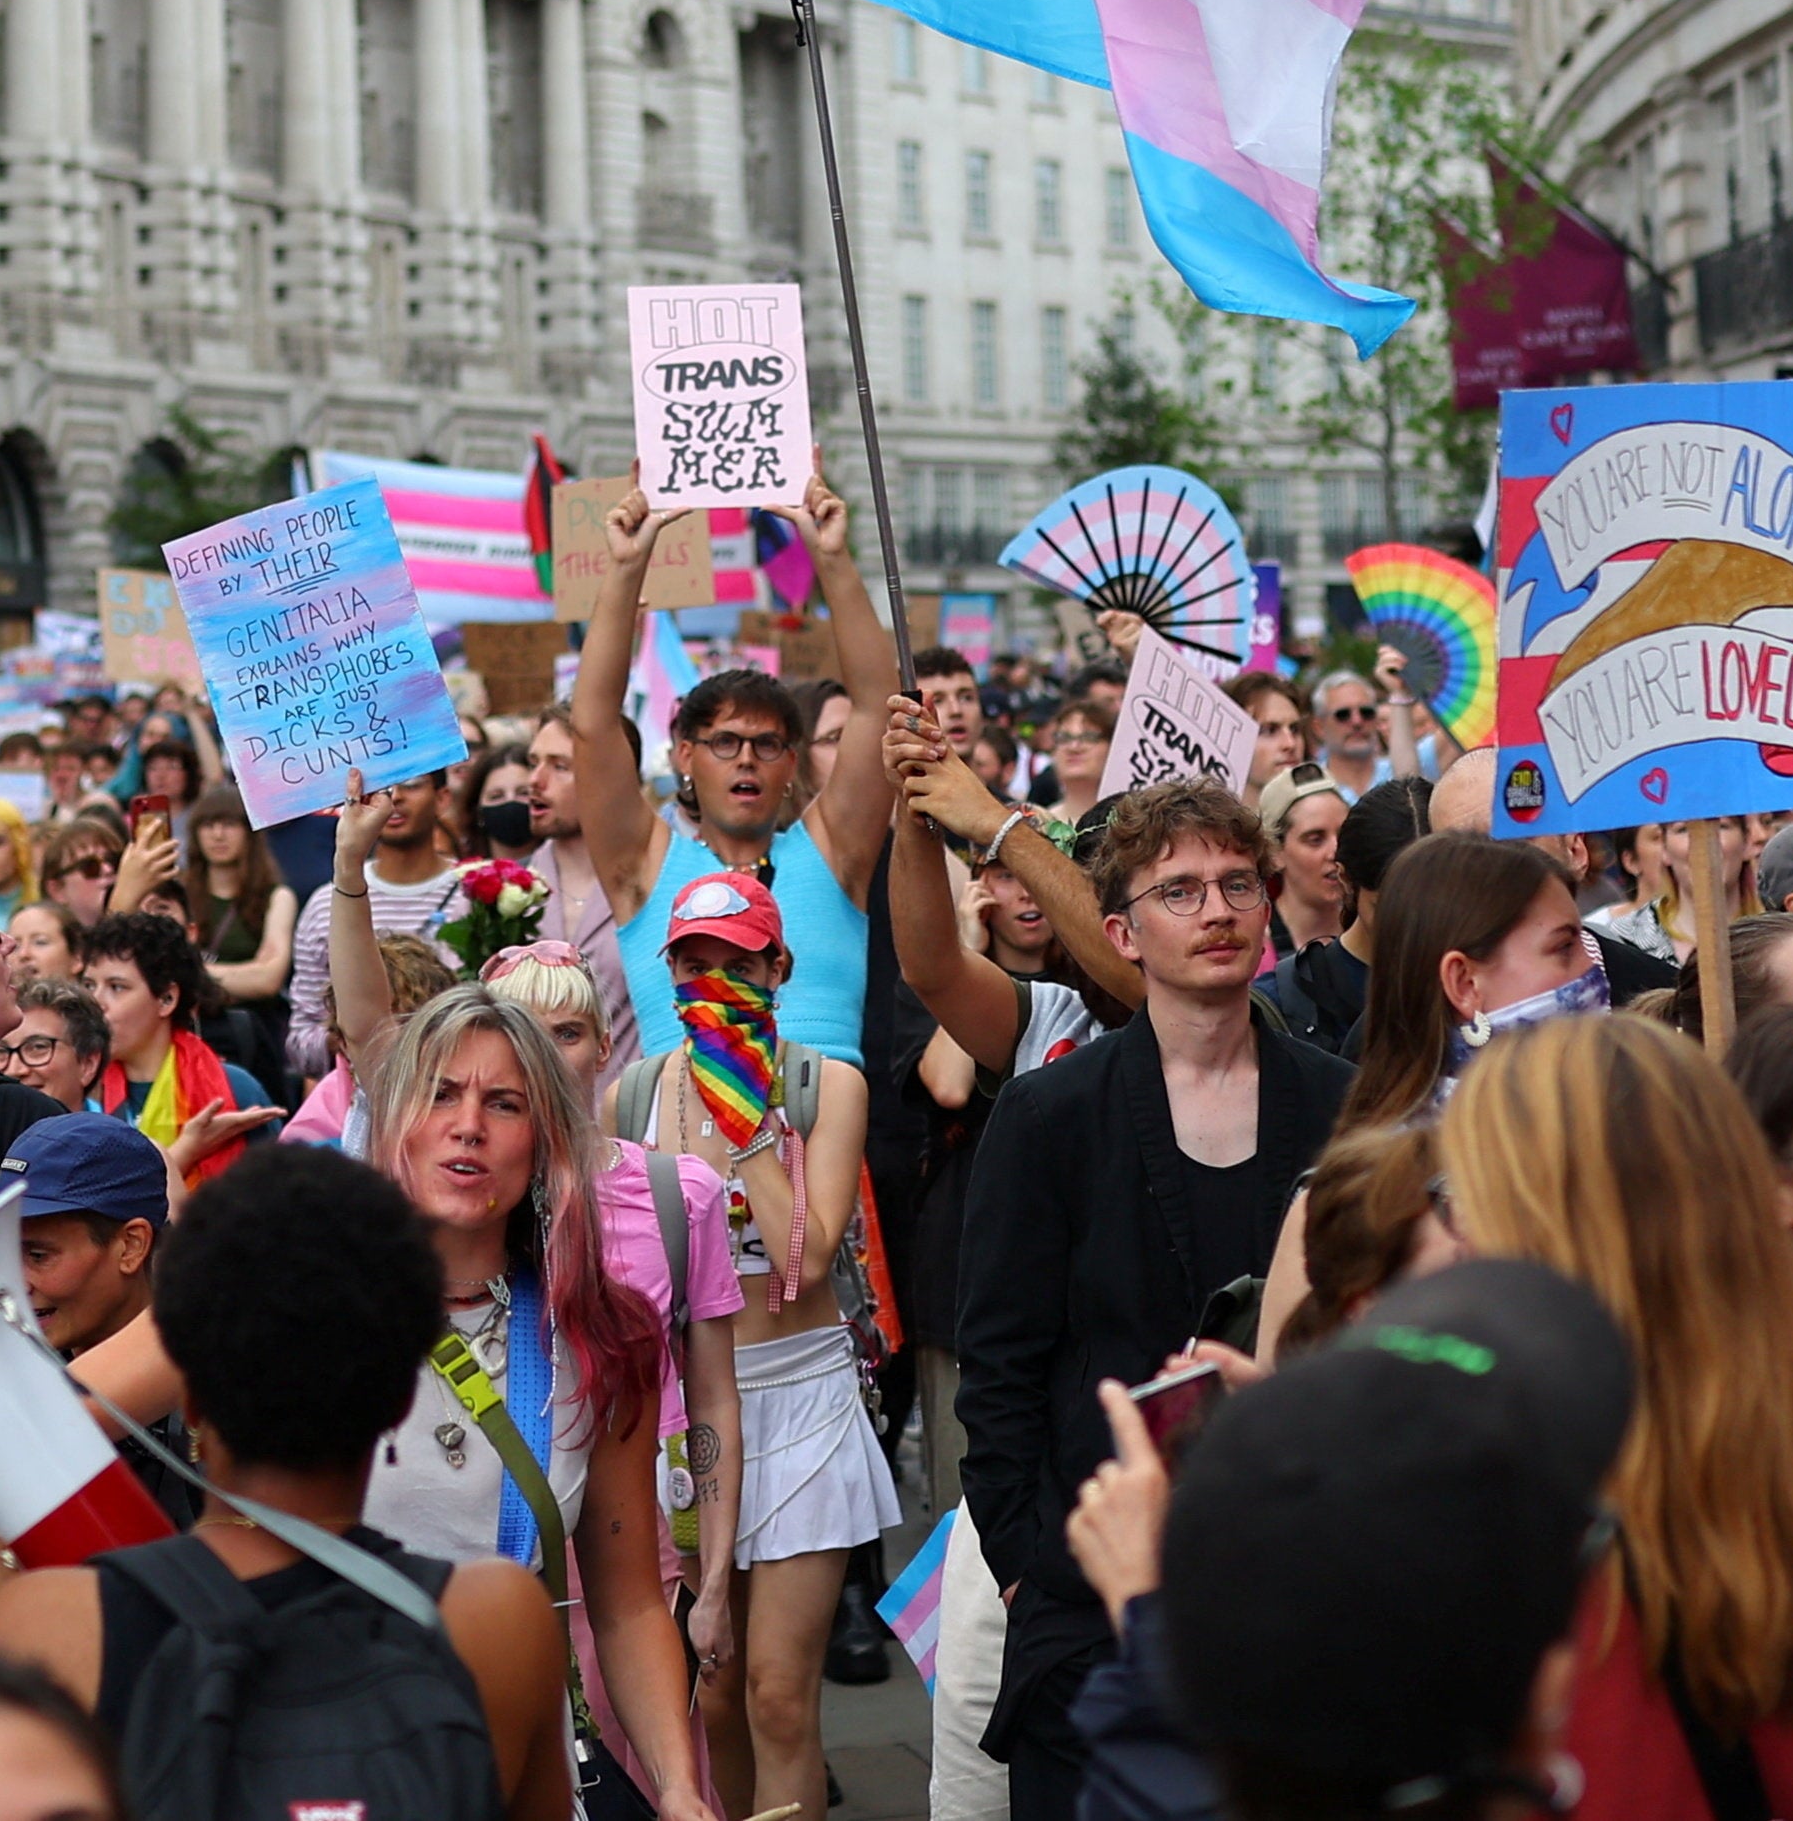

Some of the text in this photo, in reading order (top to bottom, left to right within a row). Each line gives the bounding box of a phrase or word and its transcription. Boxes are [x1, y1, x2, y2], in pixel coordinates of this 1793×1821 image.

[650, 297, 779, 348] HOT
[655, 356, 784, 393] TRANS
[658, 443, 787, 494] MER
[1544, 465, 1611, 567] YOU
[1607, 444, 1652, 521] ARE
[1661, 442, 1725, 498] NOT
[172, 499, 361, 580] DEFINING PEOPLE
[219, 541, 338, 596] BY THEIR
[559, 552, 606, 579] THE
[226, 587, 372, 658] GENITALIA
[236, 620, 376, 686] EXPLAINS WHY
[228, 641, 414, 712] TRANSPHOBES
[284, 681, 381, 722] ARE JUST
[1148, 647, 1243, 757] HOT
[1546, 670, 1623, 775] YOU
[1627, 641, 1695, 740] ARE
[244, 702, 390, 763] DICKS &
[281, 719, 409, 784] CUNTS!
[1143, 701, 1230, 783] TRANS
